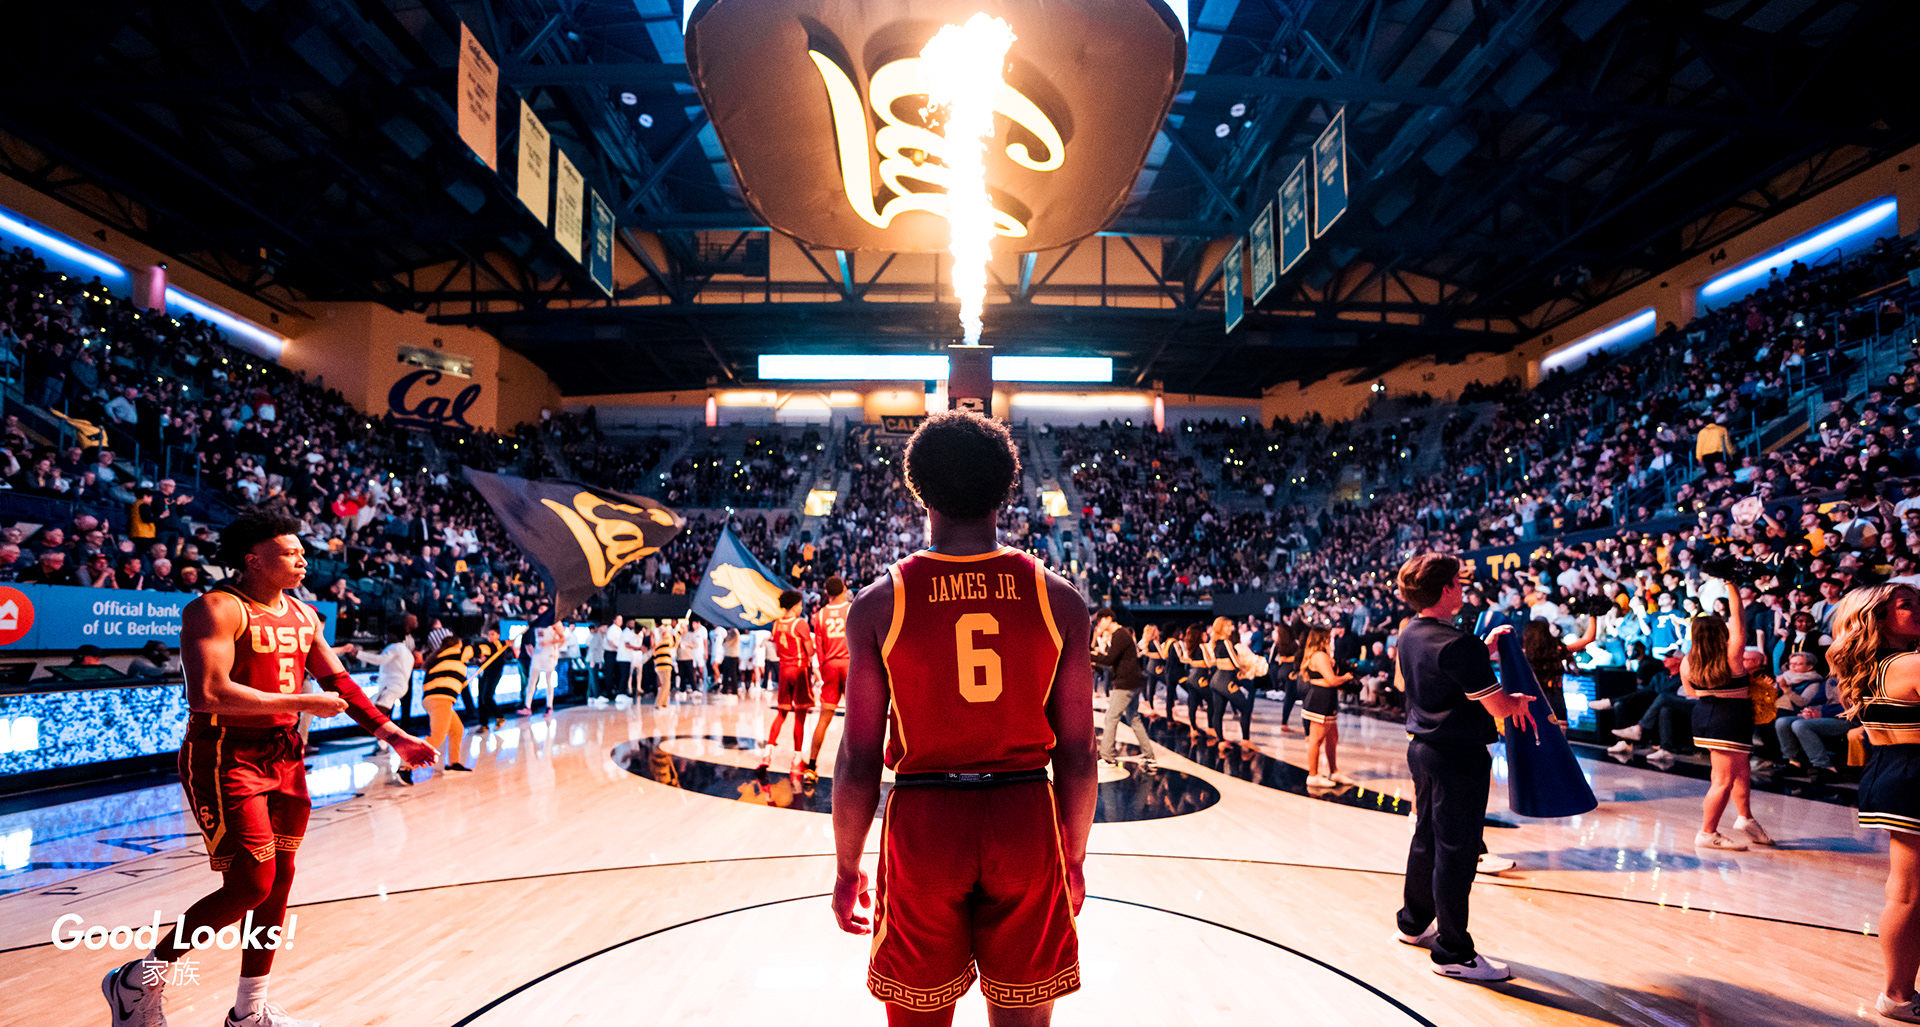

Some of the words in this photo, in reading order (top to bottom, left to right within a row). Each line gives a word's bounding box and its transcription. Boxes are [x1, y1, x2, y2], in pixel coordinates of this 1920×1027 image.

[1709, 248, 1727, 266] 14
[388, 369, 482, 432] Cal
[929, 573, 988, 602] JAMES
[995, 573, 1021, 600] JR.
[93, 601, 143, 616] Official
[148, 602, 180, 617] bank
[83, 620, 99, 635] of
[104, 621, 122, 635] UC
[250, 625, 314, 653] USC
[825, 618, 845, 638] 22
[955, 612, 1003, 703] 6
[280, 658, 295, 694] 5
